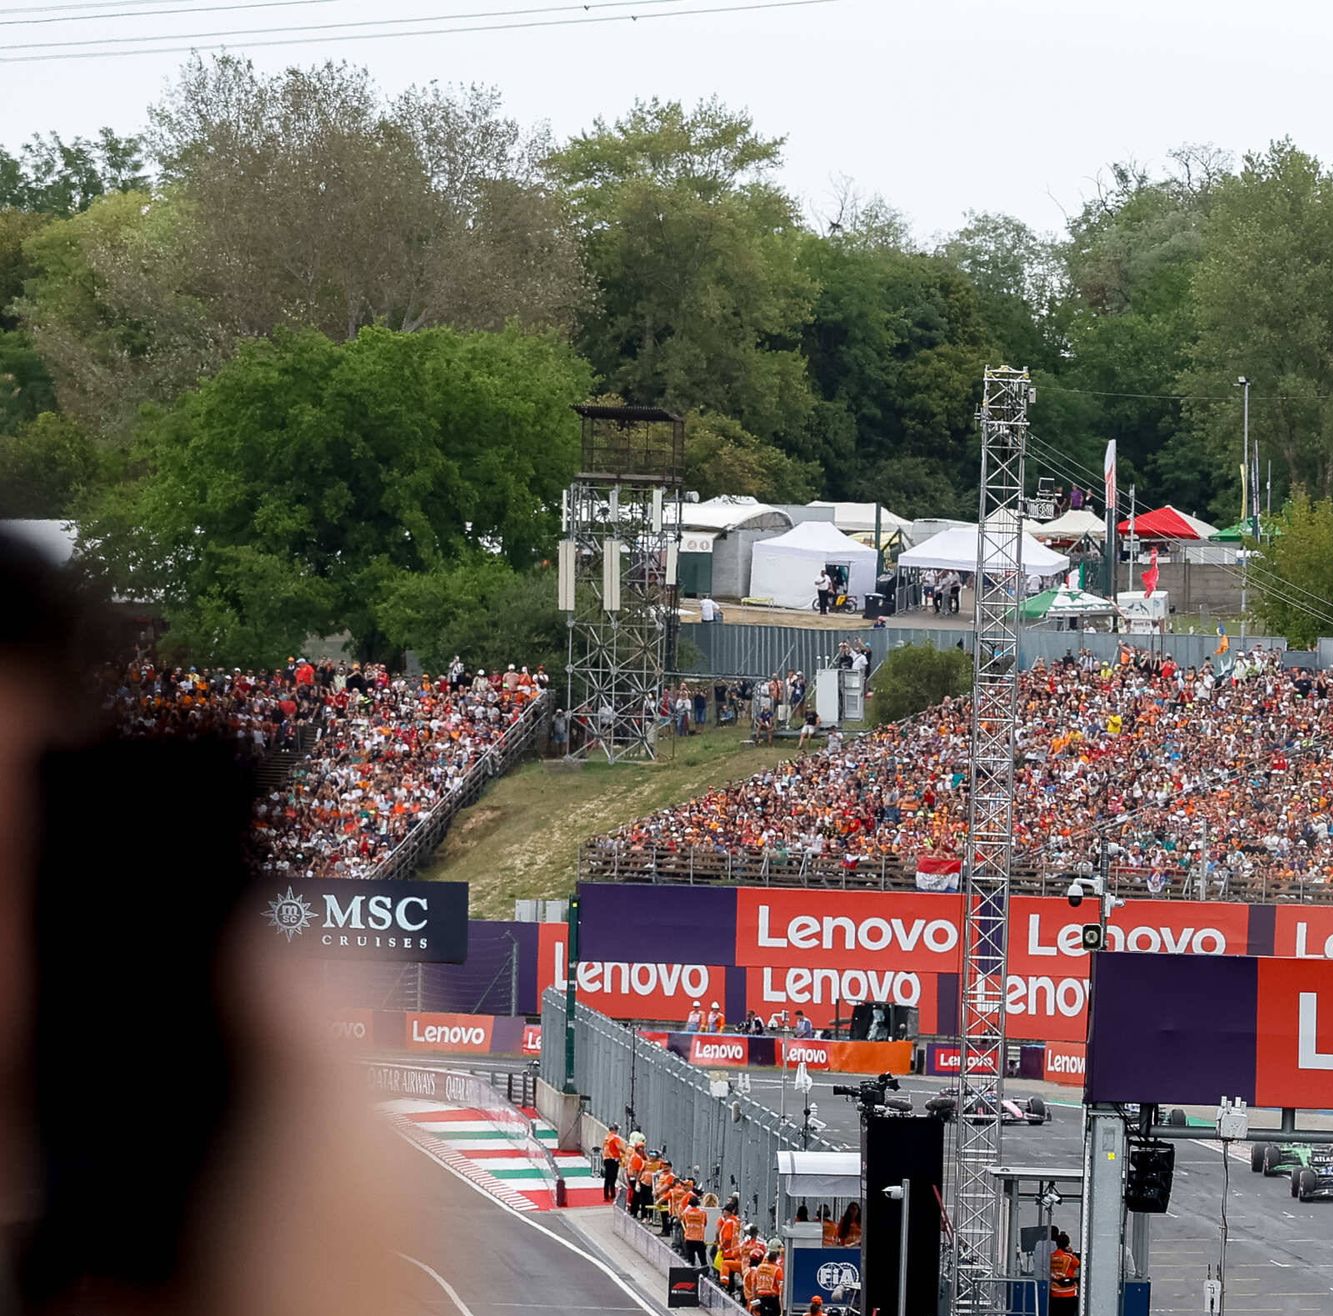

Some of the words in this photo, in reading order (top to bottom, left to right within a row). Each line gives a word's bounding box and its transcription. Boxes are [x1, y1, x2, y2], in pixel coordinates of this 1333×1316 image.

[322, 894, 428, 931] MSC
[322, 935, 428, 949] CRUISES
[758, 905, 958, 953] Lenovo
[763, 967, 921, 1007] Lenovo
[412, 1020, 485, 1045] Lenovo
[695, 1036, 744, 1060] Lenovo
